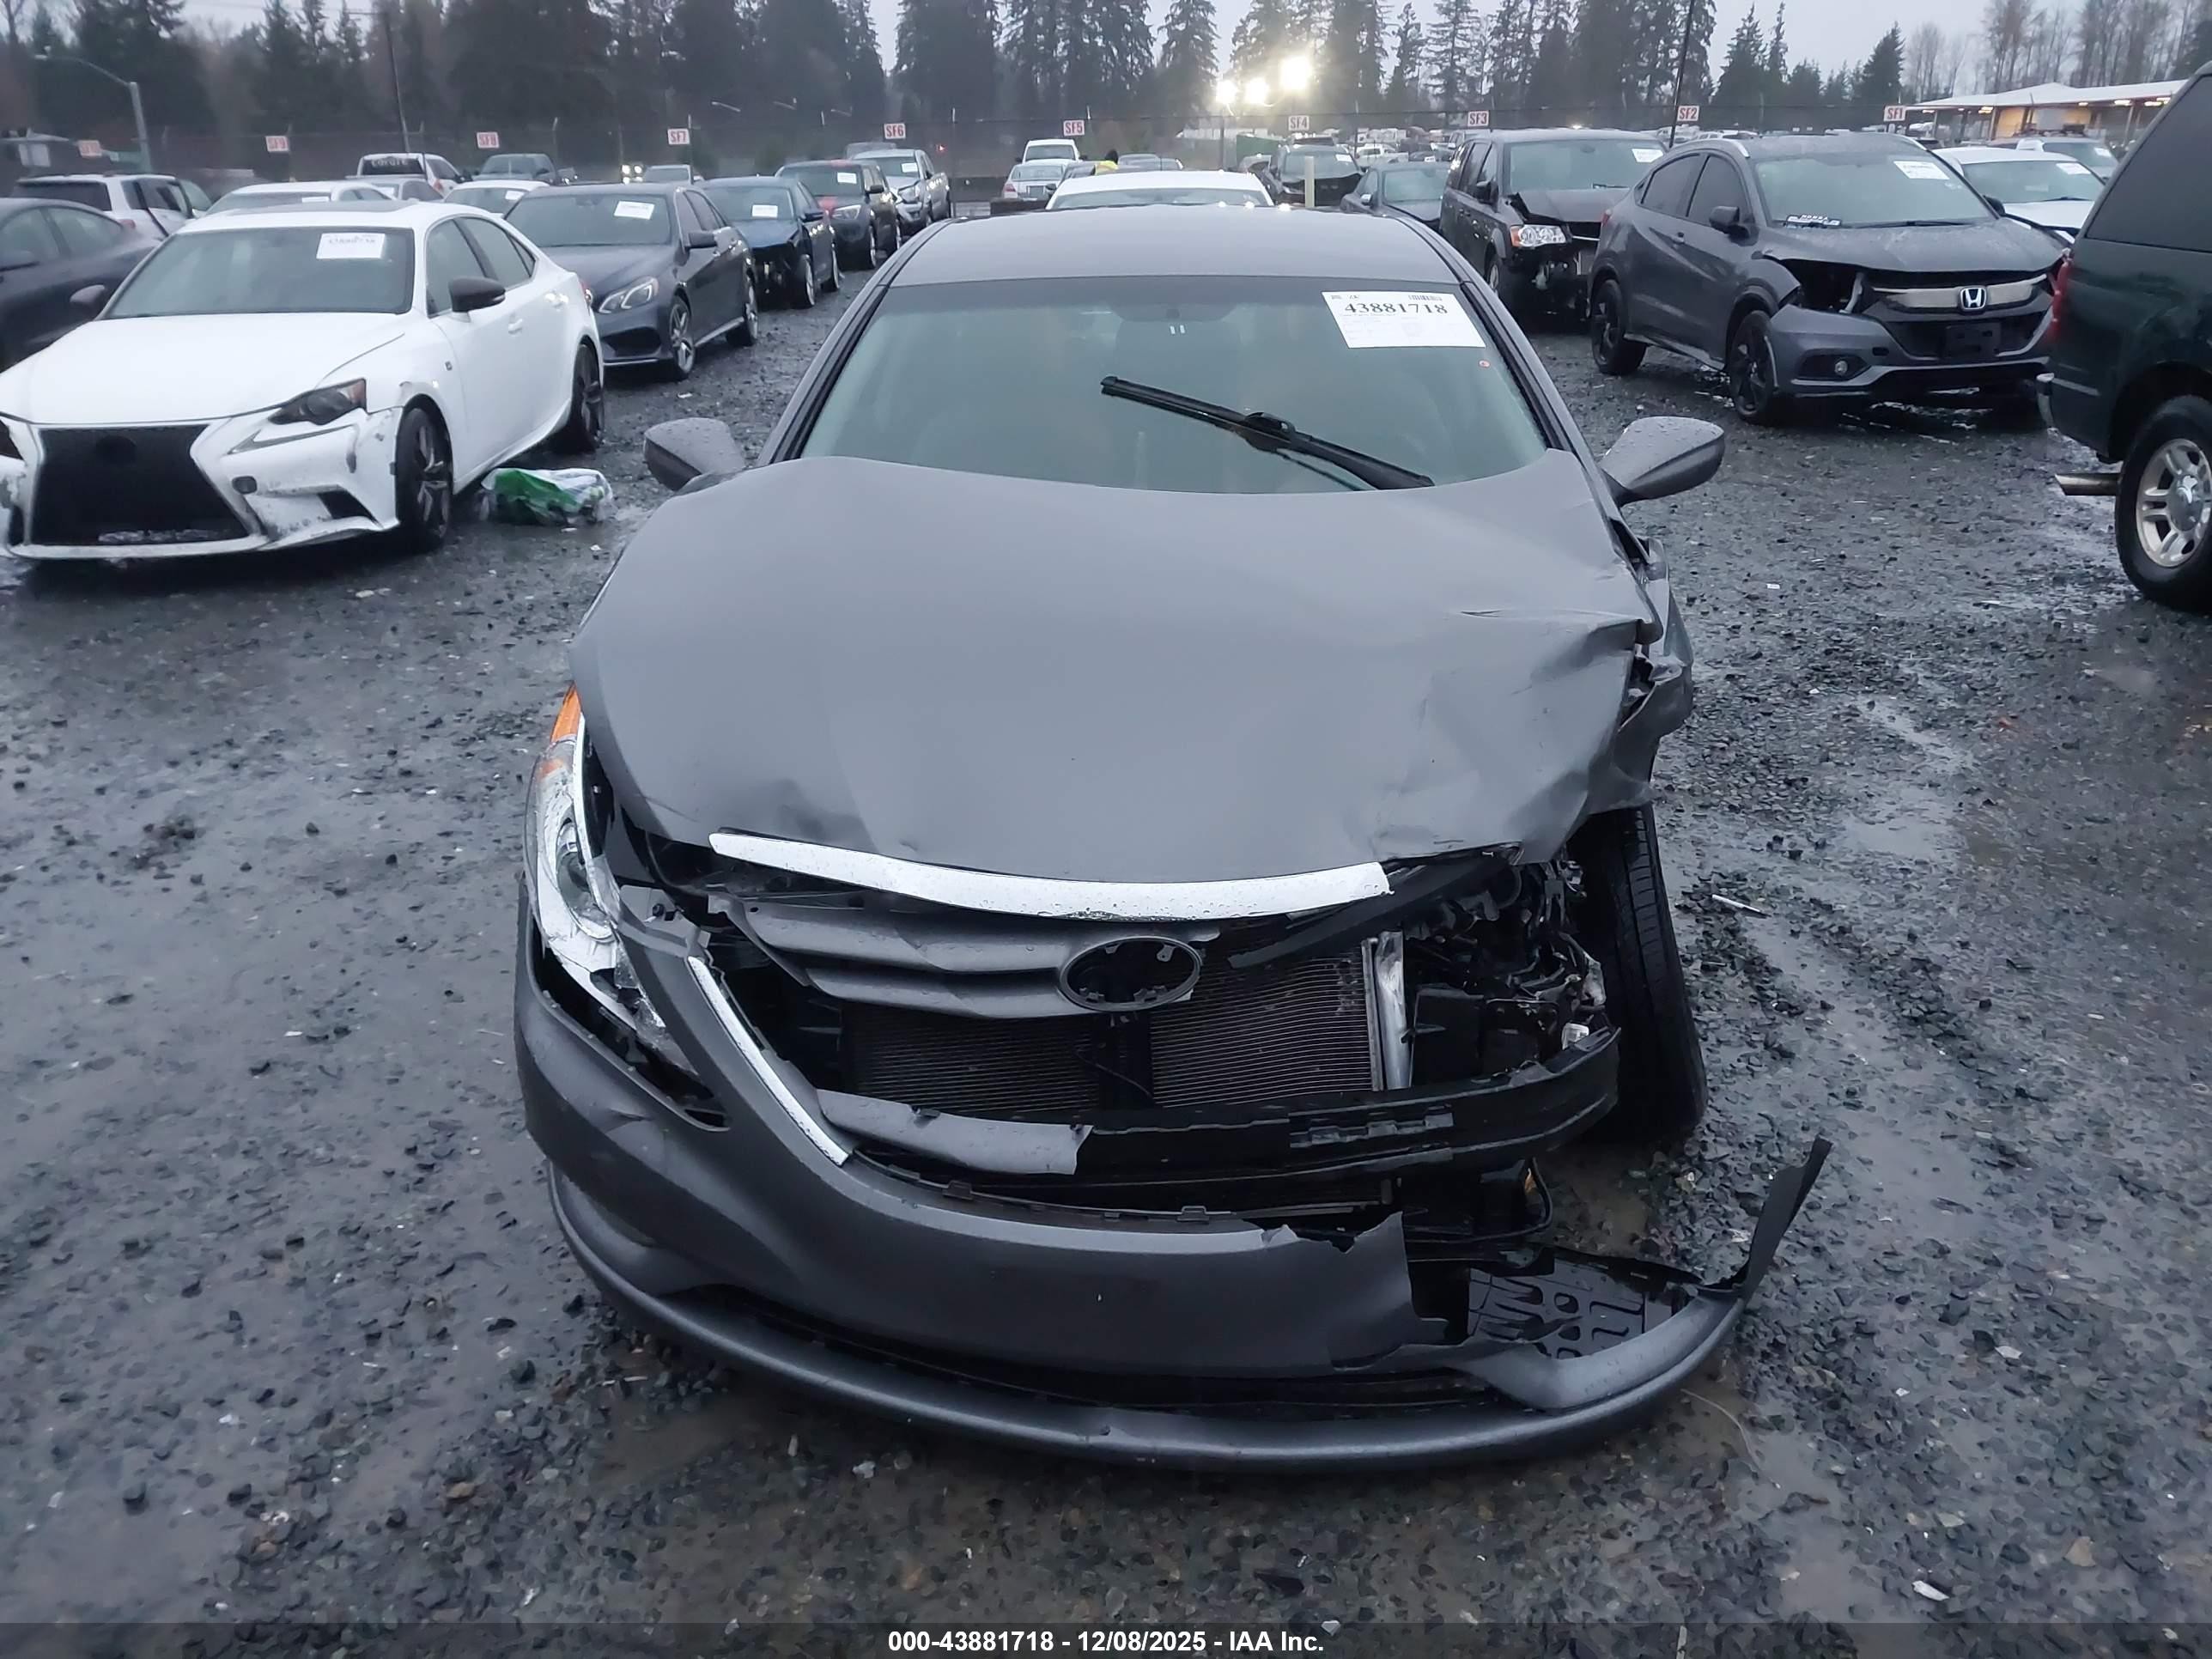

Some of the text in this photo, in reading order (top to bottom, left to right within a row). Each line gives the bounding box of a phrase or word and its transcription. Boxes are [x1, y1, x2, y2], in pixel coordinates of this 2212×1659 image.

[1469, 112, 1487, 125] SF3
[1679, 106, 1698, 119] SF2
[1887, 106, 1904, 119] SF1
[1065, 121, 1083, 134] SF5
[1290, 116, 1308, 129] SF4
[670, 130, 686, 143] SF7
[886, 125, 904, 137] SF6
[1344, 301, 1449, 314] 43881718
